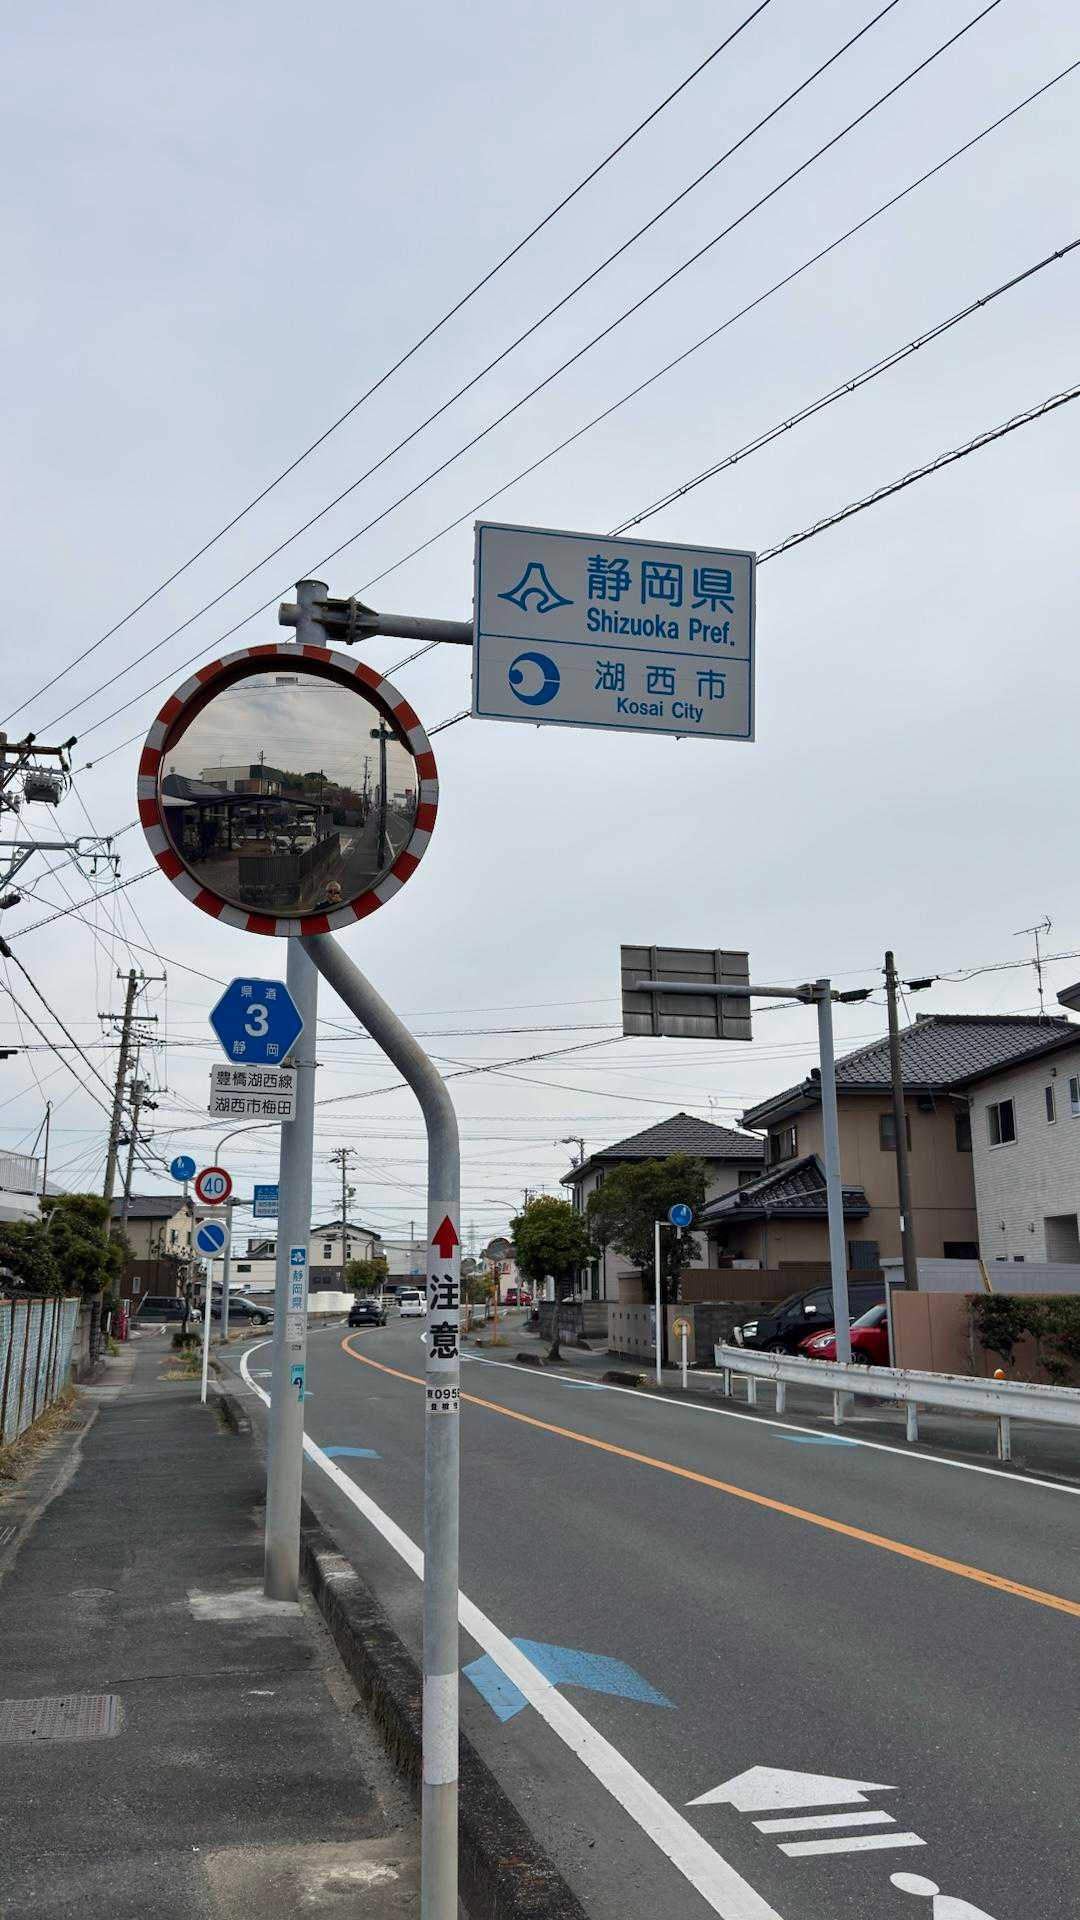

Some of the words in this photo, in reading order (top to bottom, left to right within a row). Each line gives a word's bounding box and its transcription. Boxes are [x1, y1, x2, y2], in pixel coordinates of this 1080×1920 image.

[587, 554, 735, 614] 静岡県
[586, 607, 679, 640] Shizuoka
[689, 618, 735, 646] Pref.
[594, 660, 726, 700] 湖西市
[617, 697, 663, 717] Kosai
[671, 701, 704, 723] City
[241, 985, 278, 1001] 県道
[244, 1003, 270, 1037] 3
[232, 1040, 279, 1057] 静岡
[216, 1071, 293, 1089] 豊橋湖西線
[214, 1097, 292, 1115] 湖西市梅田
[203, 1177, 224, 1194] 40
[429, 1274, 459, 1359] 注意
